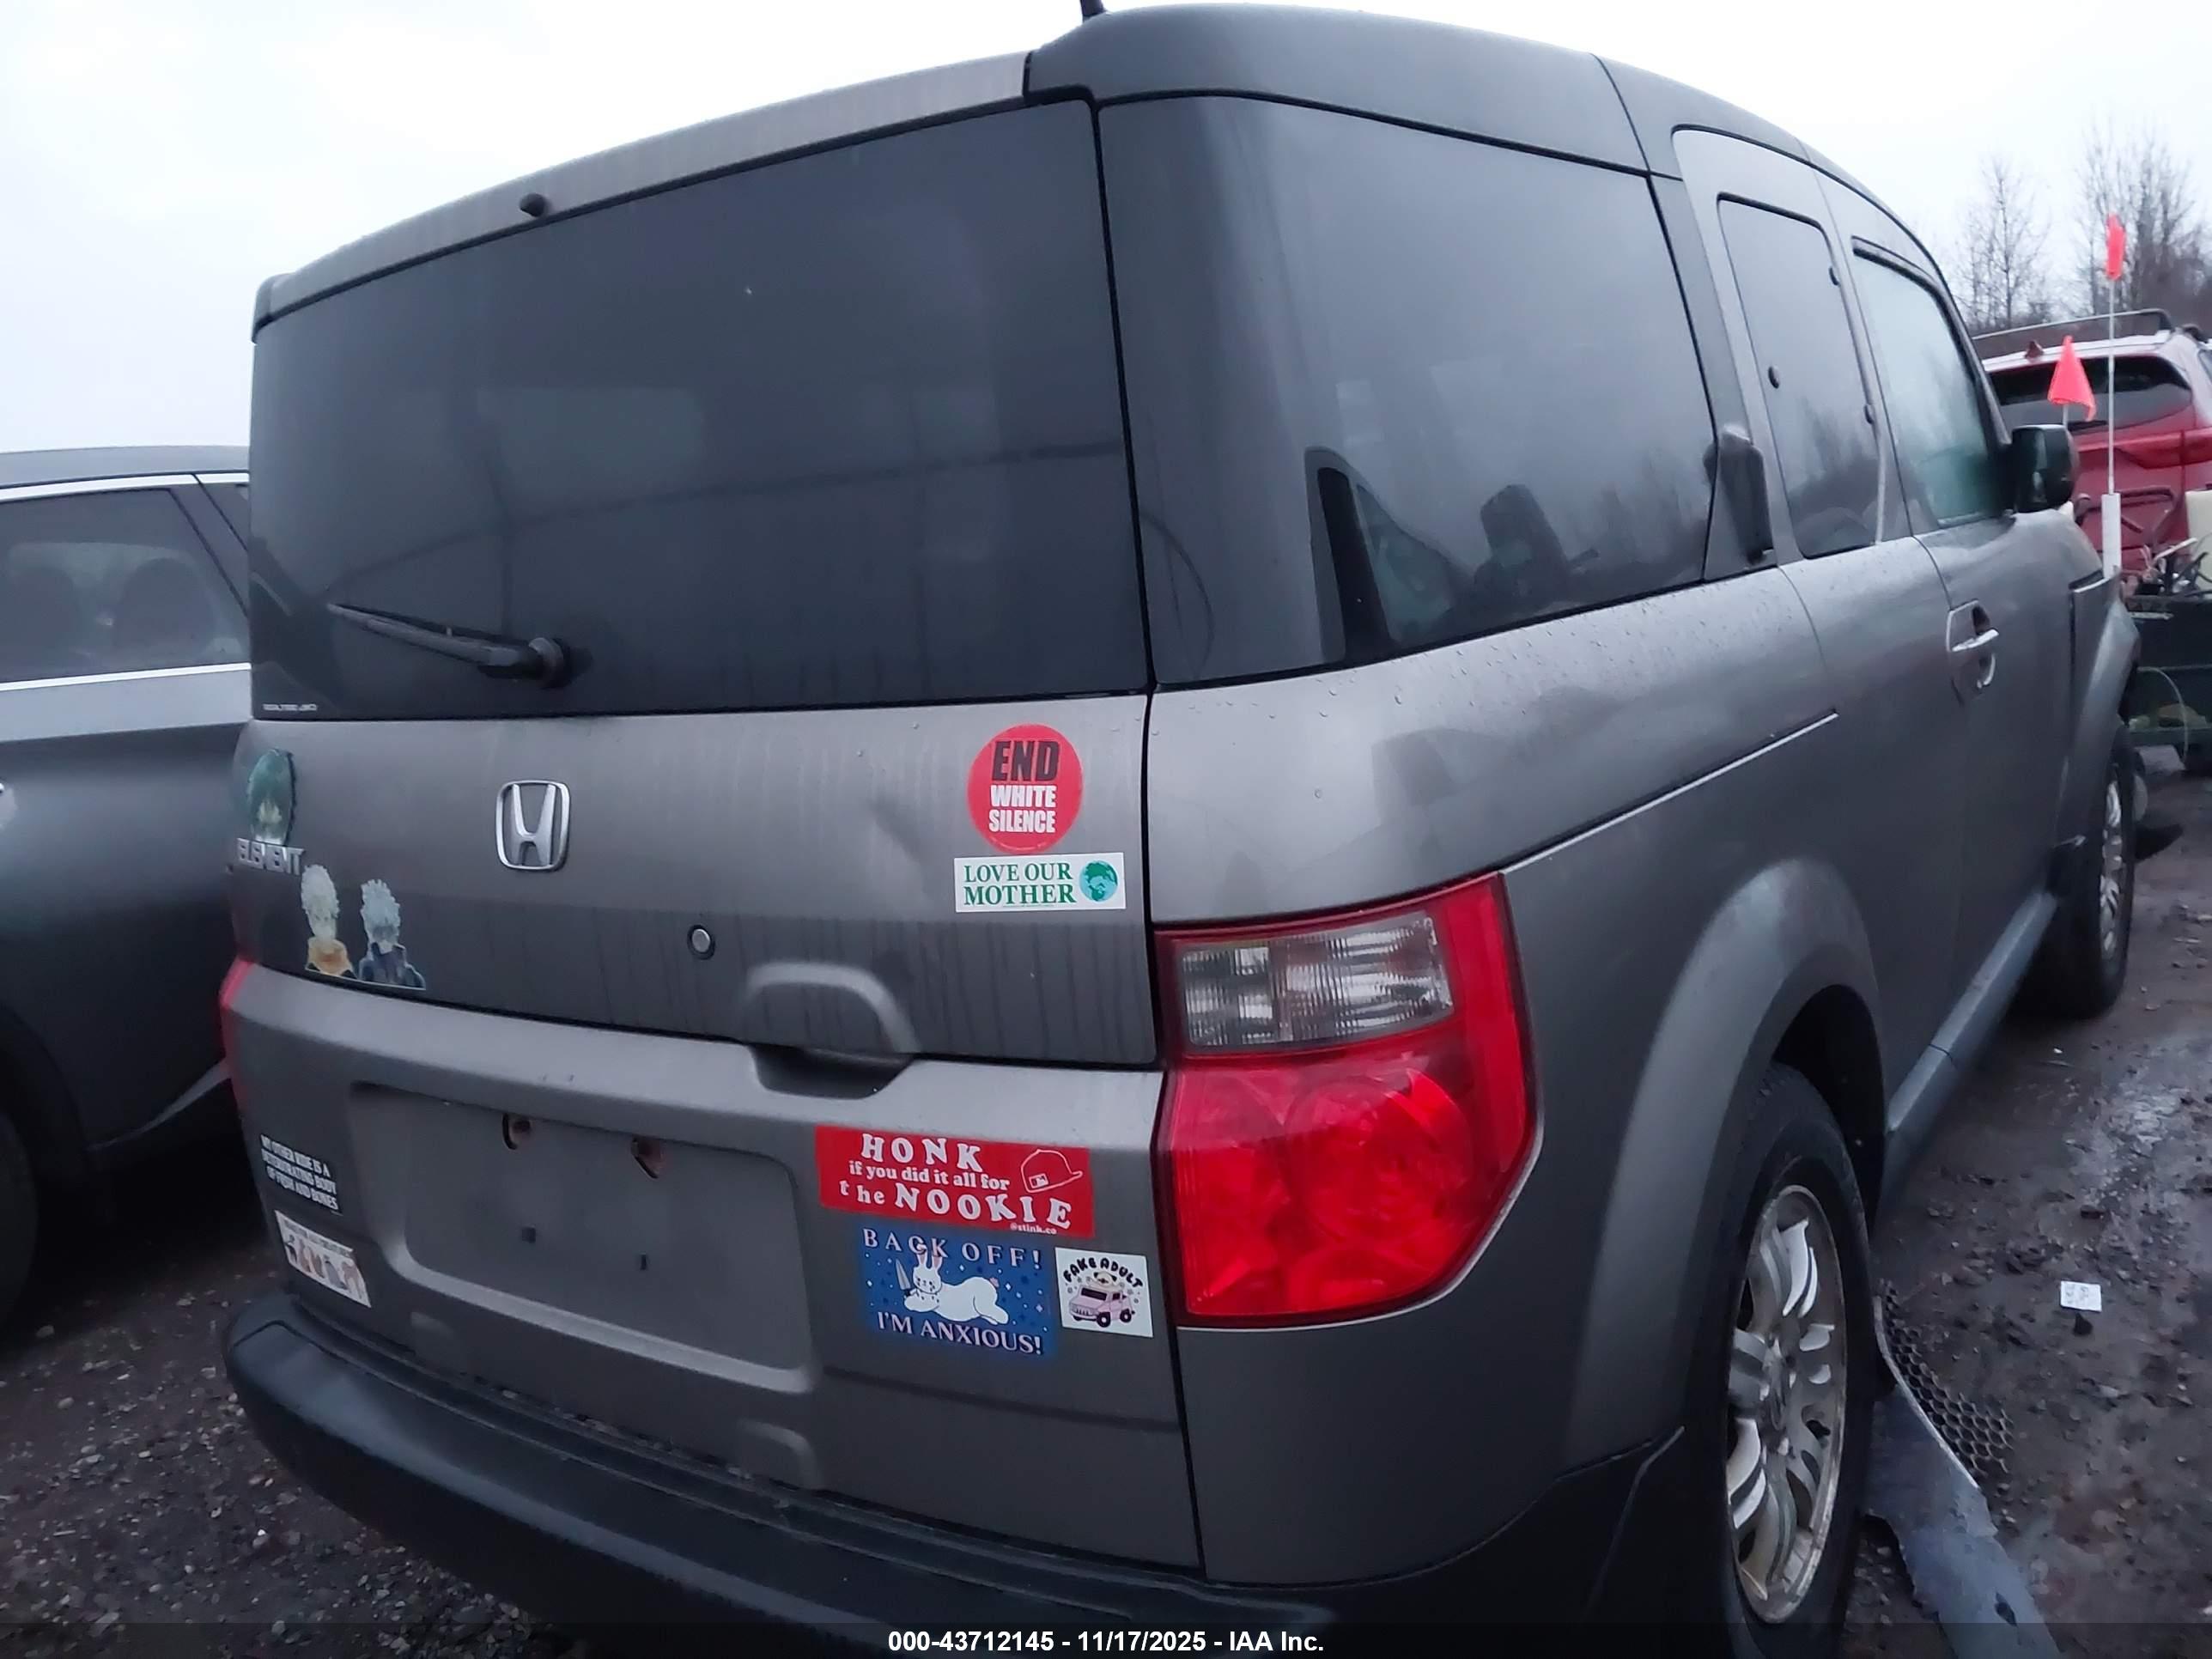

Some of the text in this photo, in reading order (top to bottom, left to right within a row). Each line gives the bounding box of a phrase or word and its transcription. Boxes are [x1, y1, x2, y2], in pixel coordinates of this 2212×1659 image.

[992, 740, 1060, 781] END
[990, 785, 1056, 808] WHITE
[988, 810, 1055, 833] SILENCE
[236, 837, 305, 876] ELEMENT
[964, 862, 1073, 883] LOVE OUR
[963, 884, 1077, 906] MOTHER
[861, 1133, 982, 1172] HONK
[849, 1160, 1010, 1191] if you did it all for
[895, 1182, 1073, 1230] NOOKIE
[862, 1228, 1041, 1269] BACK OFF!
[1063, 1257, 1143, 1287] FAKE ADULT
[878, 1311, 1042, 1355] I'M ANXIOUS!
